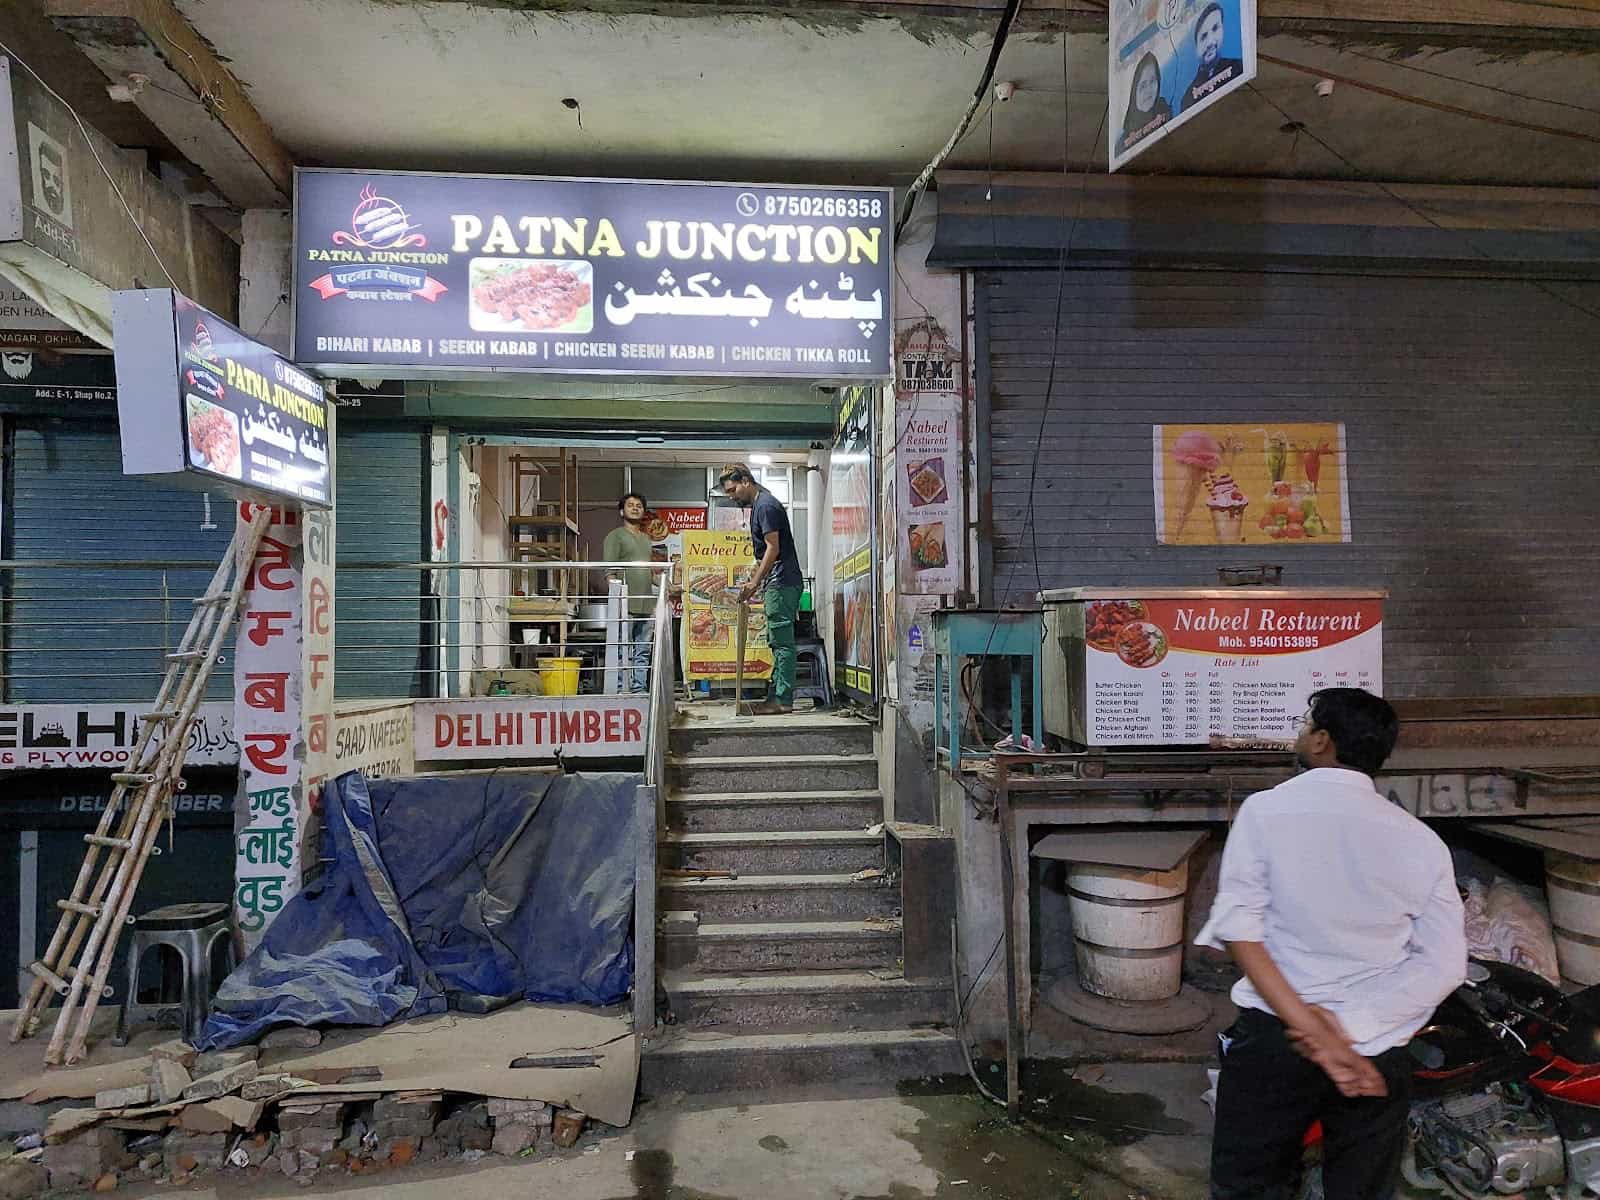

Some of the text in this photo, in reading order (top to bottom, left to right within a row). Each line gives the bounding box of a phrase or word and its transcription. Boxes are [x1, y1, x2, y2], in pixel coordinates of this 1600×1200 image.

[764, 195, 882, 218] 8750266358
[450, 214, 882, 265] PATNA JUNCTION
[308, 249, 449, 265] PATNA JUNCTION
[316, 336, 422, 354] BIHARI KABAB
[439, 339, 537, 356] SEEKH KABAB
[554, 341, 715, 360] CHICKEN SEEKH KABAB
[732, 345, 871, 363] CHICKEN TIKKA ROLL
[225, 357, 272, 405] PATNA
[272, 383, 326, 431] JUNCTION
[906, 419, 948, 435] Nabeel
[666, 511, 705, 522] Nabeel
[688, 543, 737, 556] Nabeel
[1173, 607, 1362, 632] Nabeel Resturent
[1219, 635, 1319, 648] Mob. 9540153895
[1214, 657, 1261, 667] Rate List
[1114, 681, 1141, 689] Chicken
[1232, 681, 1258, 689] Chicken
[1095, 690, 1122, 698] Chicken
[1259, 689, 1286, 697] Chicken
[1095, 698, 1122, 706] Chicken
[1095, 707, 1122, 715] Chicken
[1107, 715, 1134, 723] Chicken
[1232, 715, 1258, 723] Chicken
[434, 709, 642, 749] DELHI TIMBER
[1095, 724, 1122, 732] Chicken
[335, 716, 408, 760] SAAD NAFEES
[1095, 732, 1122, 741] Chicken
[1, 751, 130, 764] & PLYWOO
